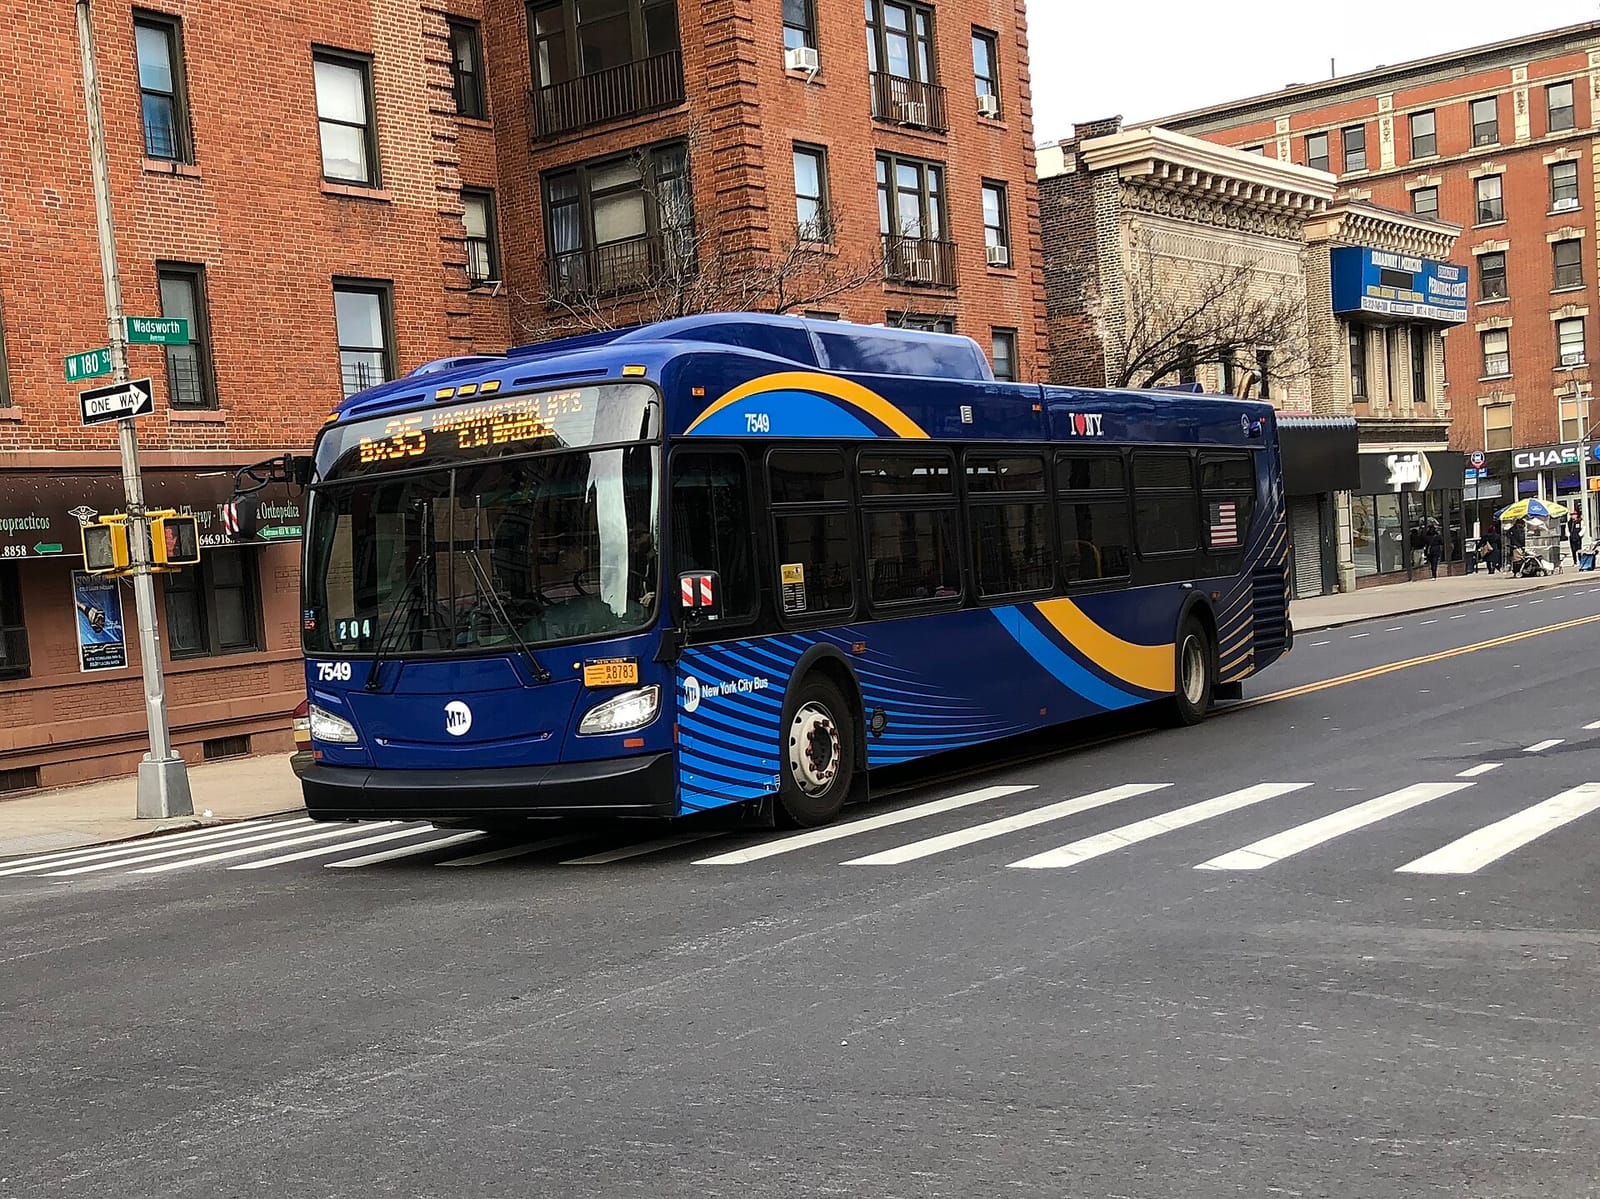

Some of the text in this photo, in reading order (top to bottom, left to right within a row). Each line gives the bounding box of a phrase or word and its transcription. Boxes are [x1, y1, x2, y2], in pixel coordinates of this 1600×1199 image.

[133, 319, 180, 334] Wadsworth
[67, 358, 77, 377] W
[81, 353, 99, 374] 180
[91, 392, 140, 413] ONE WAY
[744, 413, 770, 432] 7549
[1514, 445, 1592, 469] CHASE
[261, 499, 300, 524] Orthopedica
[317, 662, 351, 681] 7549
[701, 684, 719, 698] New
[719, 680, 737, 695] York
[737, 678, 753, 693] City
[753, 676, 769, 690] Bus
